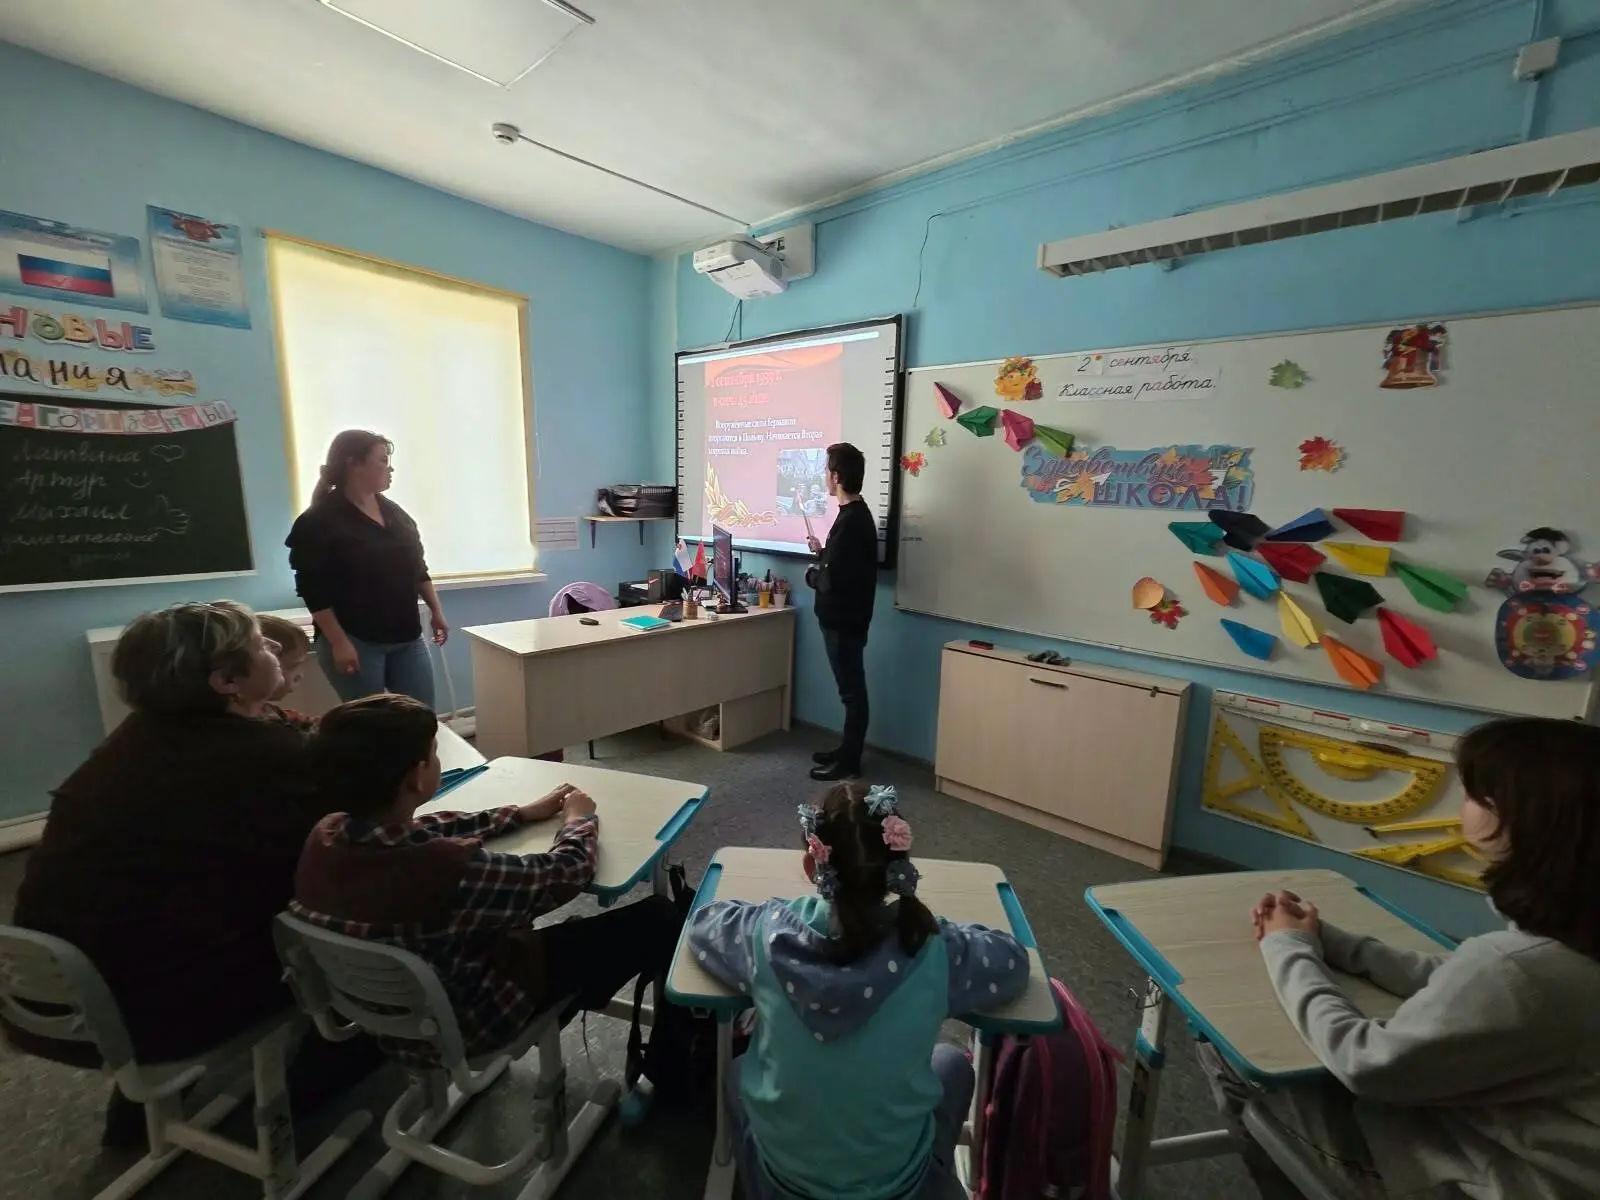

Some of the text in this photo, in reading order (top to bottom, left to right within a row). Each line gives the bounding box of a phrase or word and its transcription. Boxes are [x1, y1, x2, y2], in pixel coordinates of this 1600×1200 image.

[0, 305, 155, 351] НОВЫЕ
[1077, 357, 1092, 373] 2
[1058, 383, 1134, 397] Классная
[1094, 482, 1248, 511] ШКОЛА!
